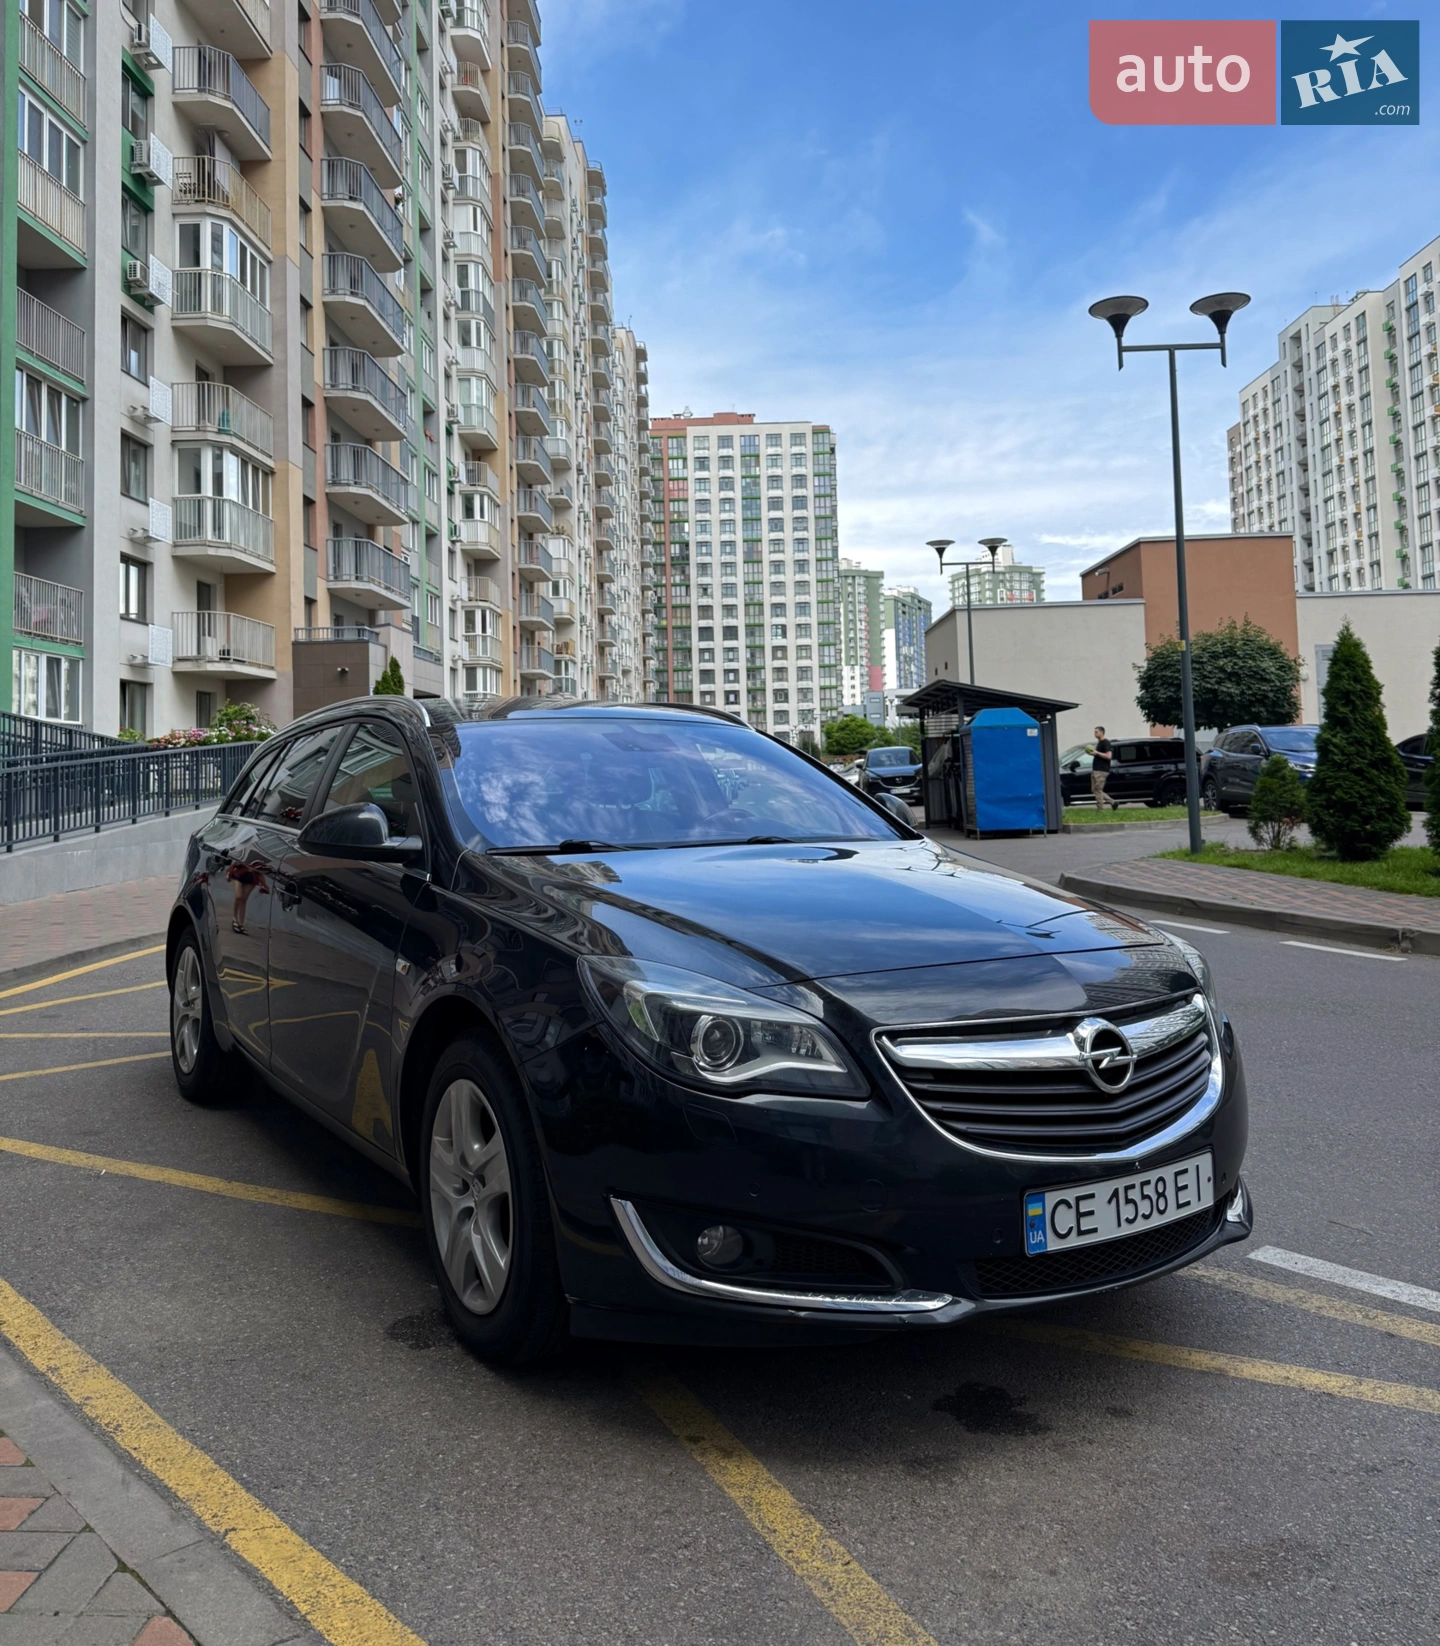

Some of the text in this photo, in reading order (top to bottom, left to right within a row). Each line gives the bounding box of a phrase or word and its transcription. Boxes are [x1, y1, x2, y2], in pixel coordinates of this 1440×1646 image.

[1050, 1164, 1202, 1240] CE 1558 EI
[1029, 1231, 1045, 1245] UA
